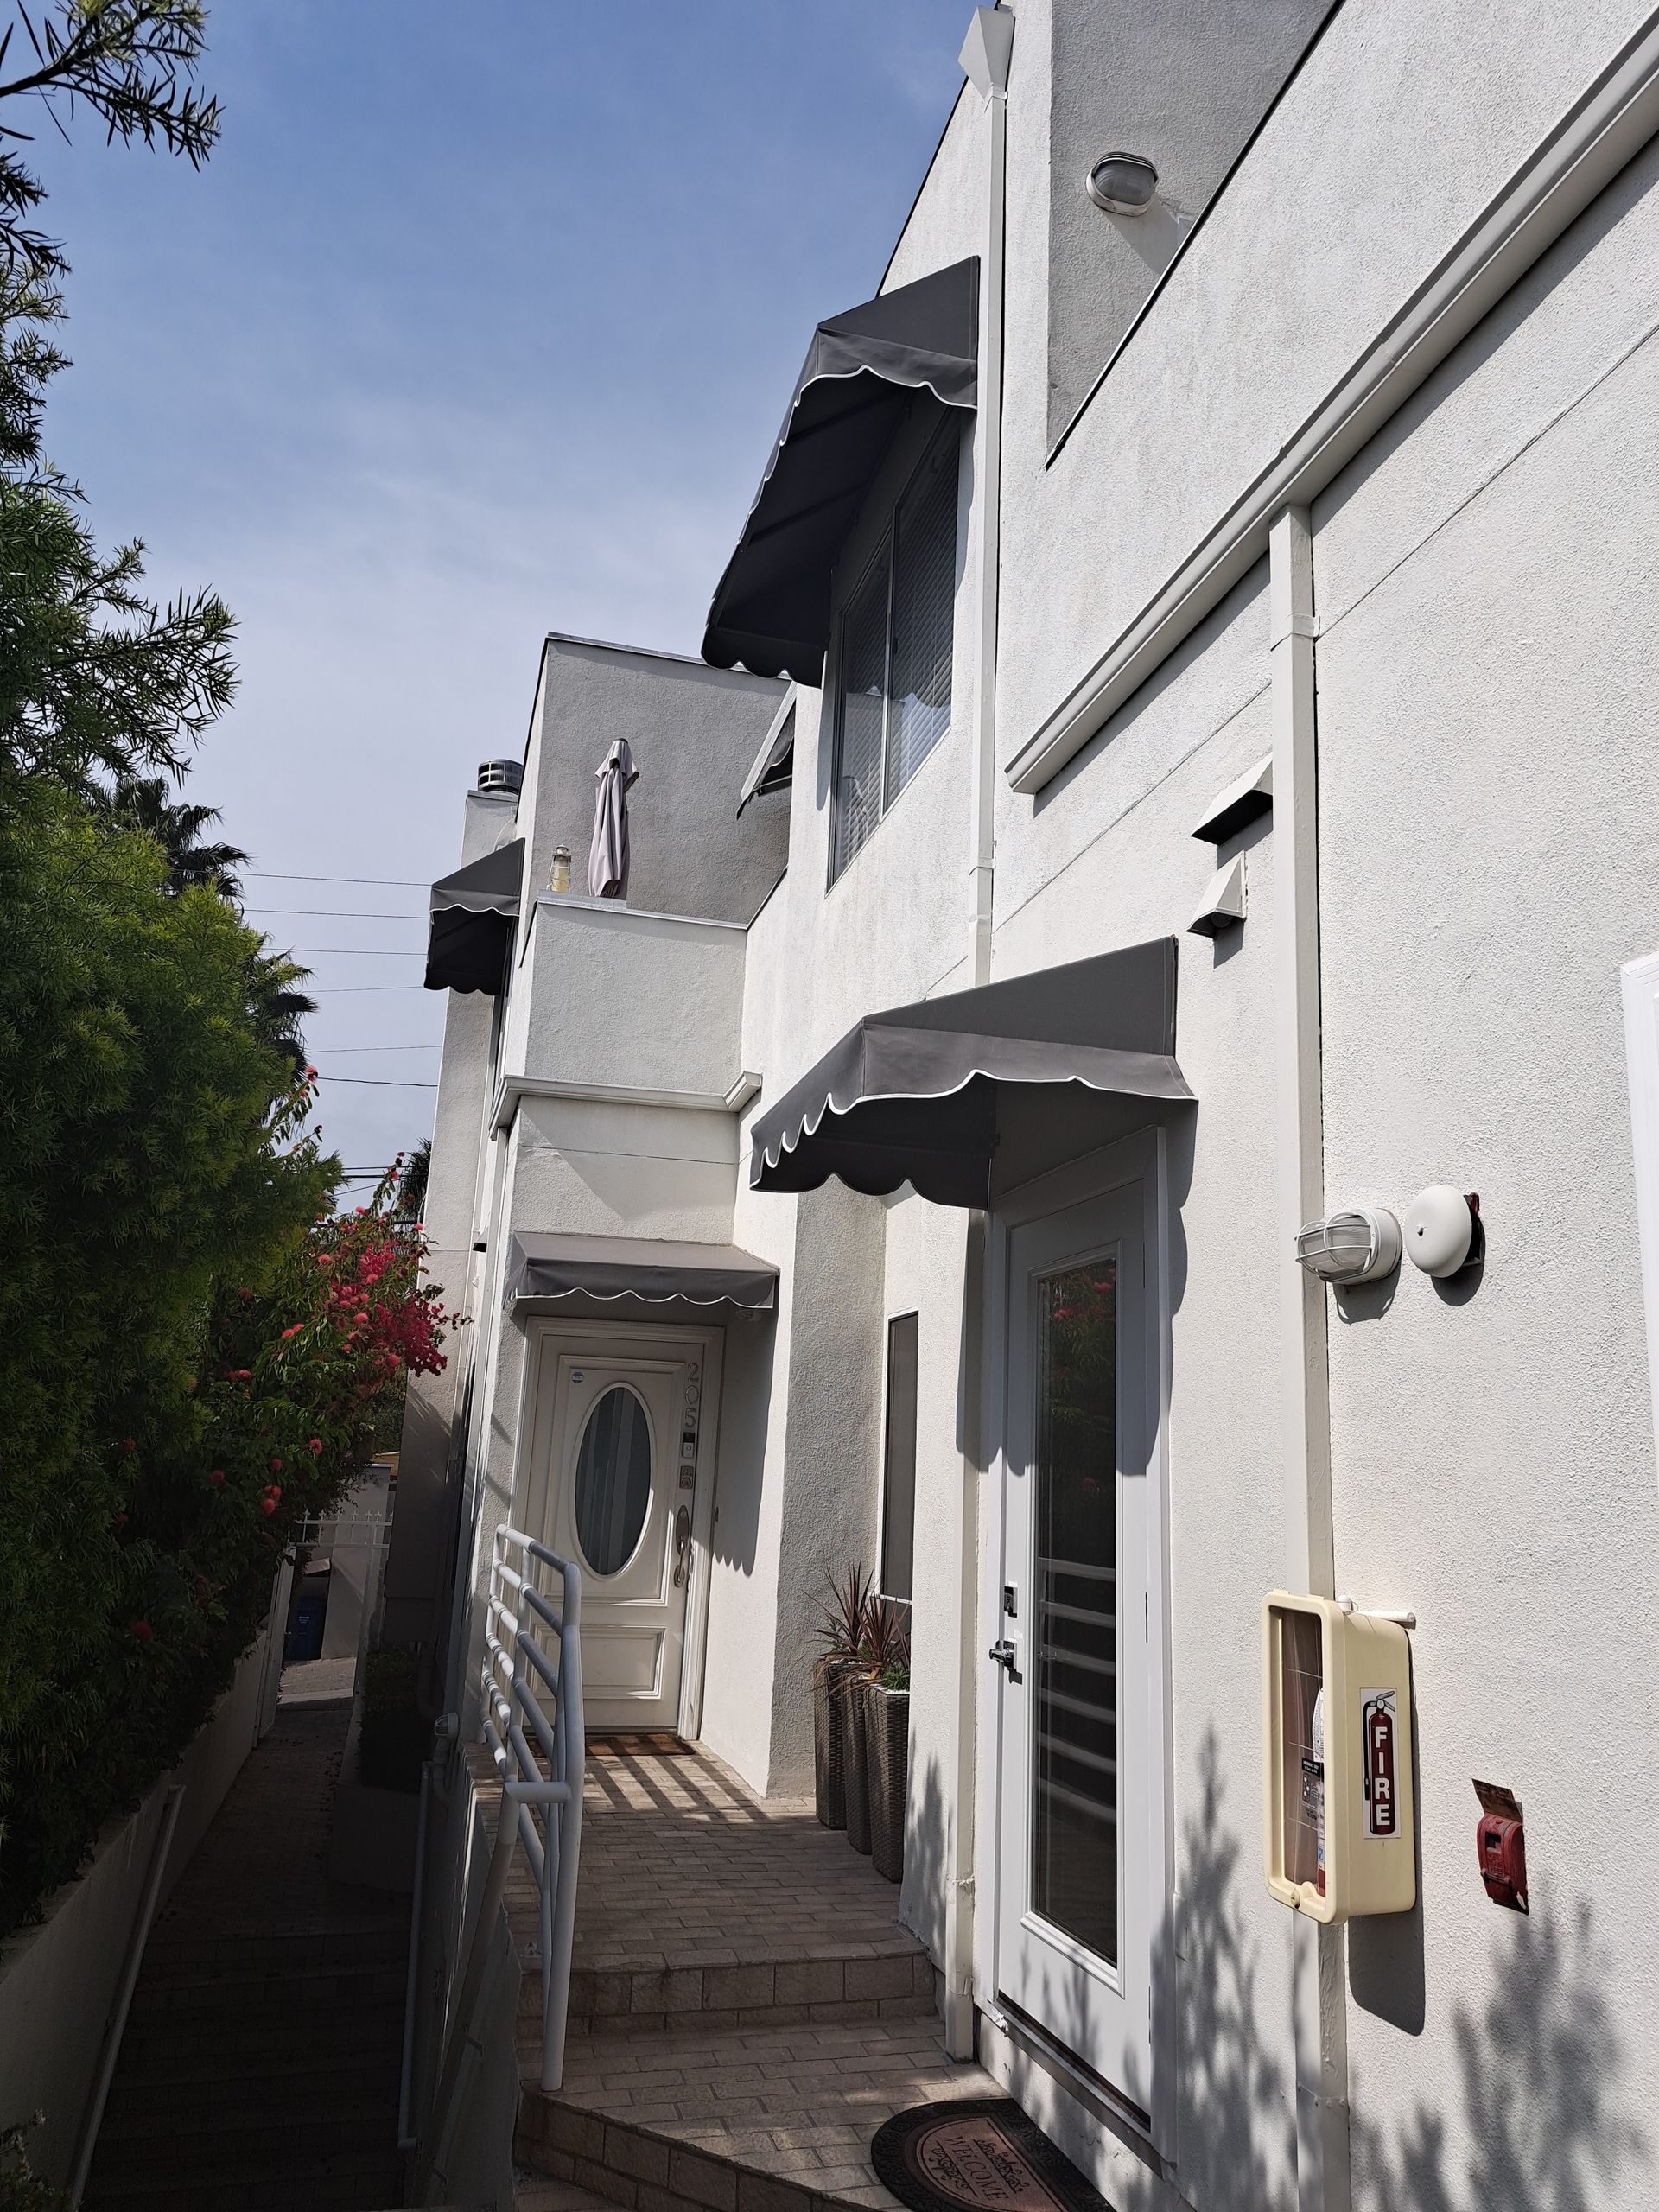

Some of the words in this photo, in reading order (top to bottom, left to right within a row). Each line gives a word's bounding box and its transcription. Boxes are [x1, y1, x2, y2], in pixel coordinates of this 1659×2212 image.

[685, 1362, 699, 1428] 205
[1374, 1726, 1390, 1826] FIRE
[944, 2135, 1009, 2201] WELCOME
